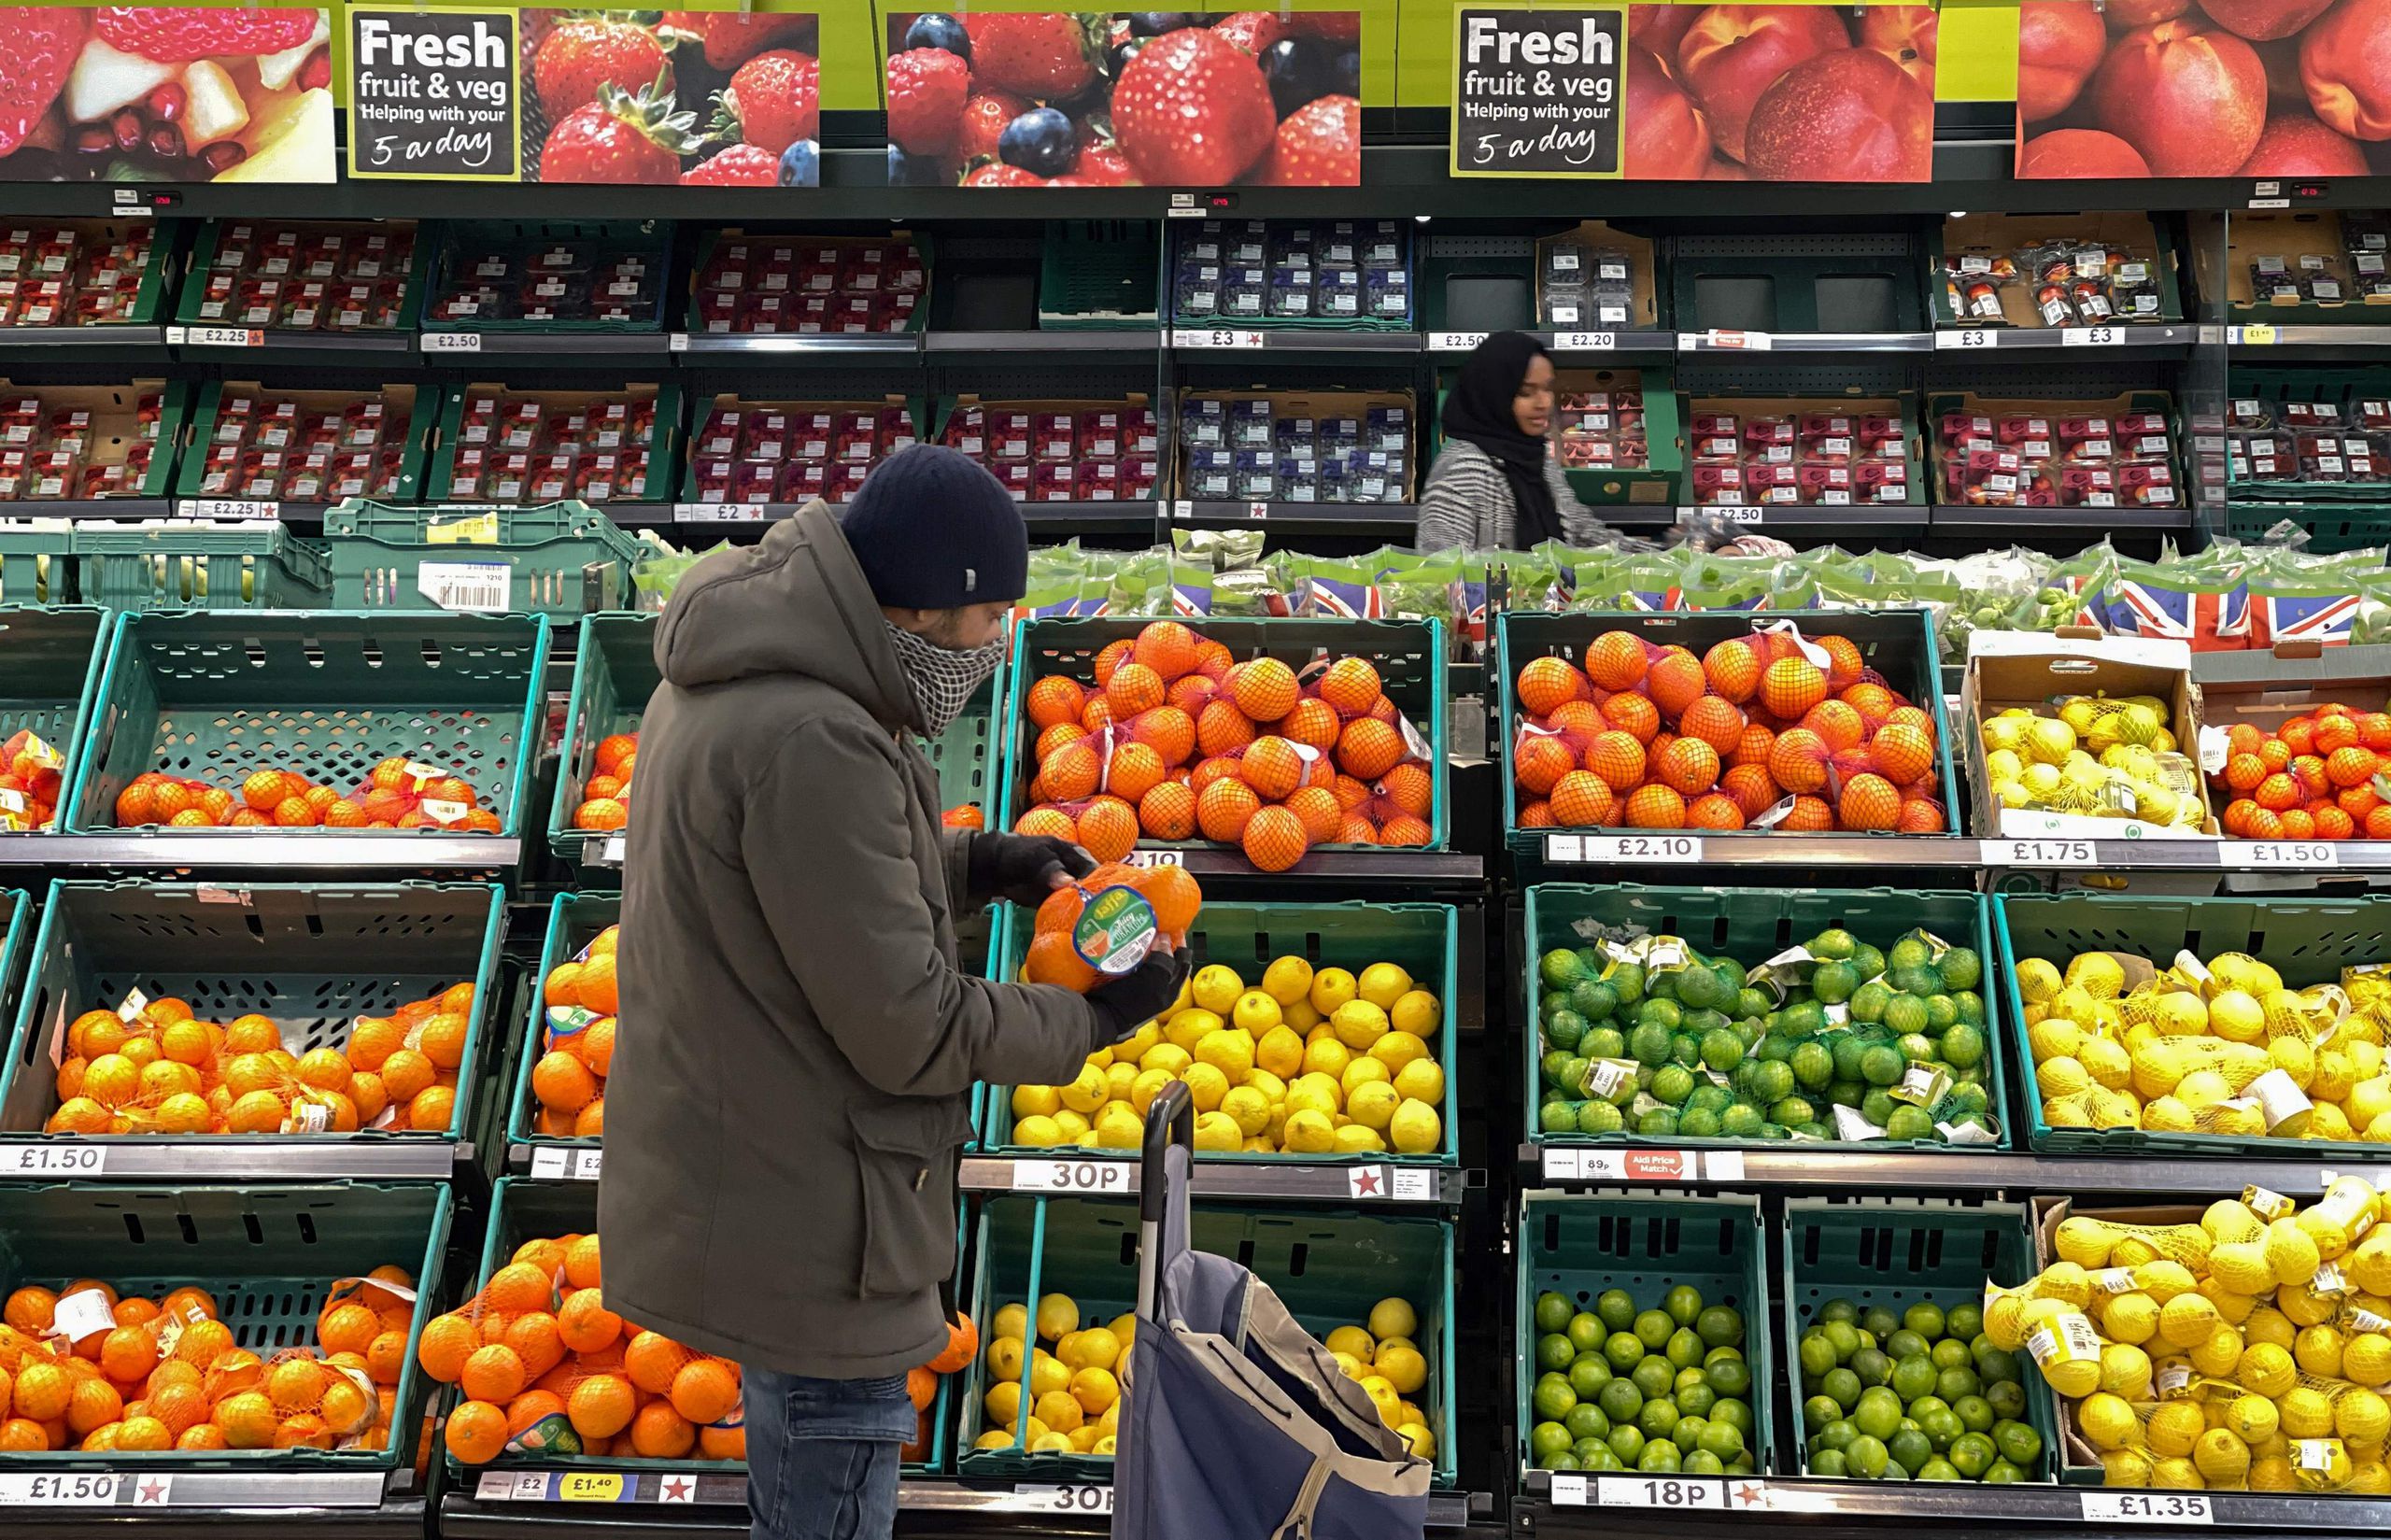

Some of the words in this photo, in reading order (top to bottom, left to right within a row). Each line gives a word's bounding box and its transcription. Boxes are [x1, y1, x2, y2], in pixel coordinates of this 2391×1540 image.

[360, 19, 505, 68] Fresh
[1467, 17, 1613, 64] Fresh
[359, 71, 421, 97] fruit
[427, 72, 450, 99] &
[456, 80, 506, 106] veg
[1464, 70, 1526, 95] fruit
[1533, 70, 1555, 96] &
[1563, 78, 1613, 103] veg
[361, 104, 424, 123] Helping
[428, 106, 464, 121] with
[468, 109, 505, 125] your
[1465, 103, 1528, 121] Helping
[1533, 103, 1568, 119] with
[1573, 106, 1610, 122] your
[371, 135, 399, 165] 5
[405, 141, 432, 160] a
[435, 126, 492, 167] day
[1473, 134, 1502, 163] 5
[1508, 138, 1535, 158] a
[1538, 123, 1595, 164] day
[205, 330, 246, 343] £2.25
[438, 335, 478, 346] £2.50
[1211, 331, 1234, 346] £3
[1446, 335, 1485, 346] £2.50
[1572, 334, 1611, 346] £2.20
[1961, 331, 1984, 346] £3
[2089, 328, 2112, 344] £3
[213, 502, 254, 515] £2.25
[717, 504, 739, 520] £2
[1719, 509, 1759, 520] £2.50
[1618, 838, 1691, 855] £2.10
[2013, 842, 2089, 860] £1.75
[2253, 845, 2330, 861] £1.50
[1123, 853, 1177, 867] 2.10
[20, 1148, 98, 1169] £1.50
[1588, 1160, 1609, 1170] 89p
[1652, 1156, 1675, 1165] Price
[30, 1476, 112, 1498] £1.50
[522, 1478, 541, 1490] £2
[573, 1478, 612, 1491] £1.40
[1644, 1480, 1705, 1505] 18p
[2119, 1495, 2205, 1516] £1.35
